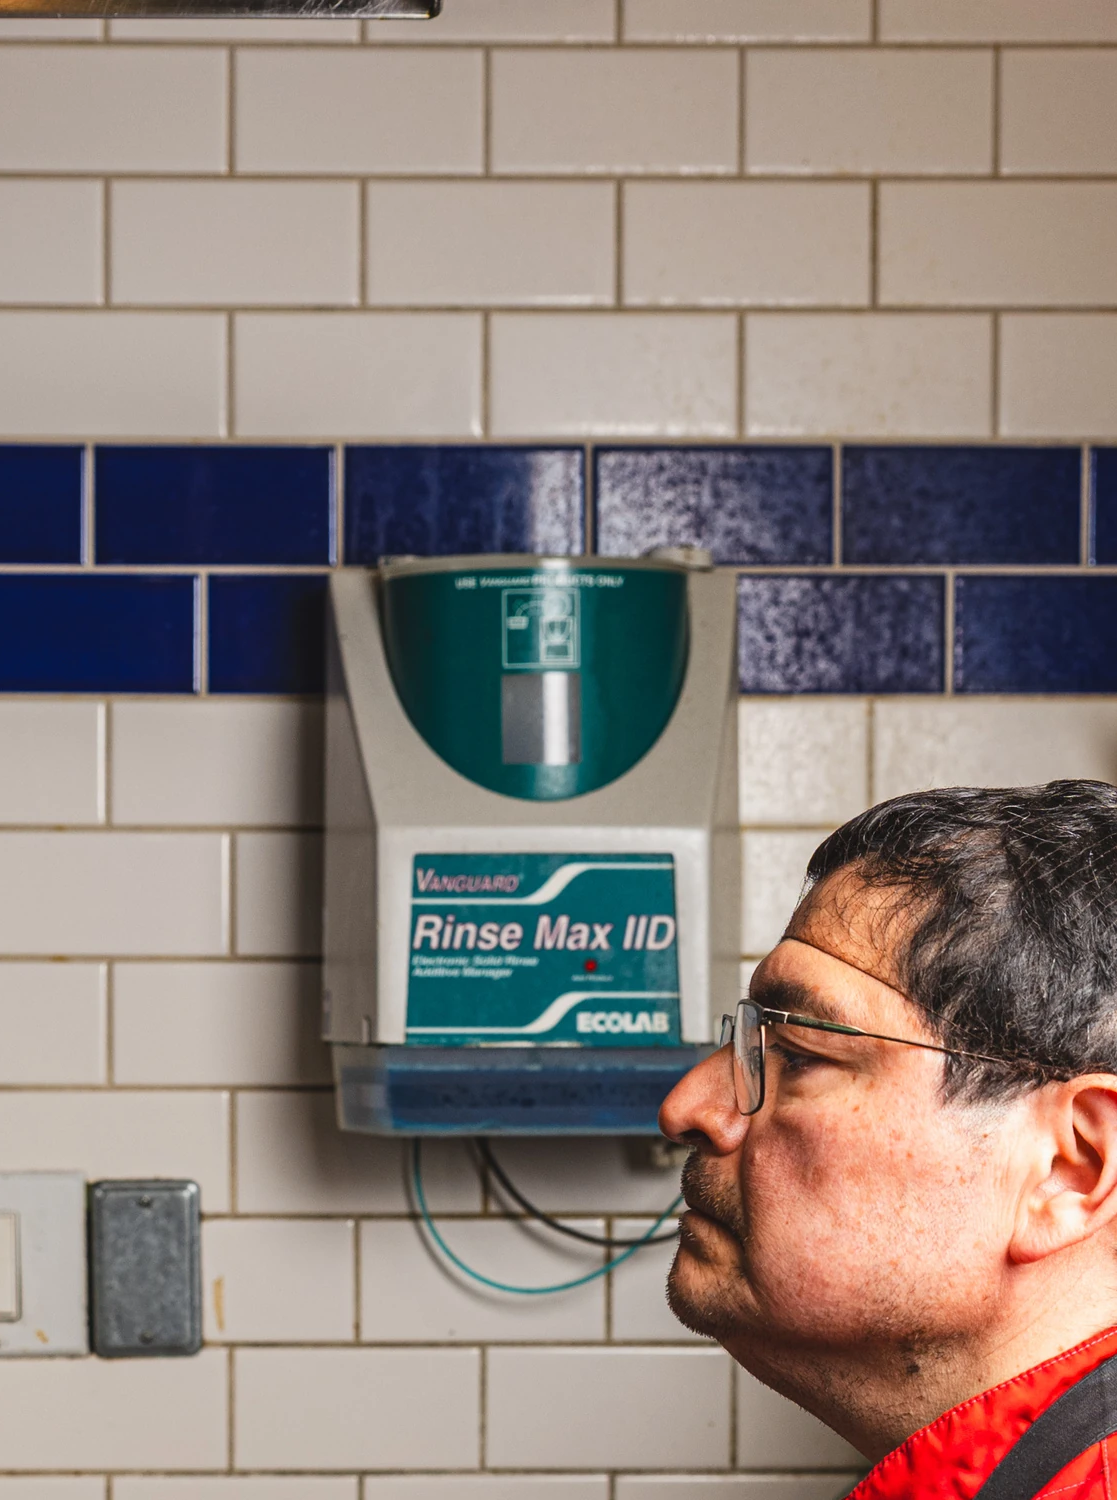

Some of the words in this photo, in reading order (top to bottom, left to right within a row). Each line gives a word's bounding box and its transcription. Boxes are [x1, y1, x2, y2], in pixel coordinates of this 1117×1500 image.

[531, 574, 595, 589] PROUCTS
[413, 914, 524, 951] Rinse
[533, 914, 614, 951] Max
[622, 914, 677, 951] IID
[575, 1011, 670, 1034] ECOLAB
